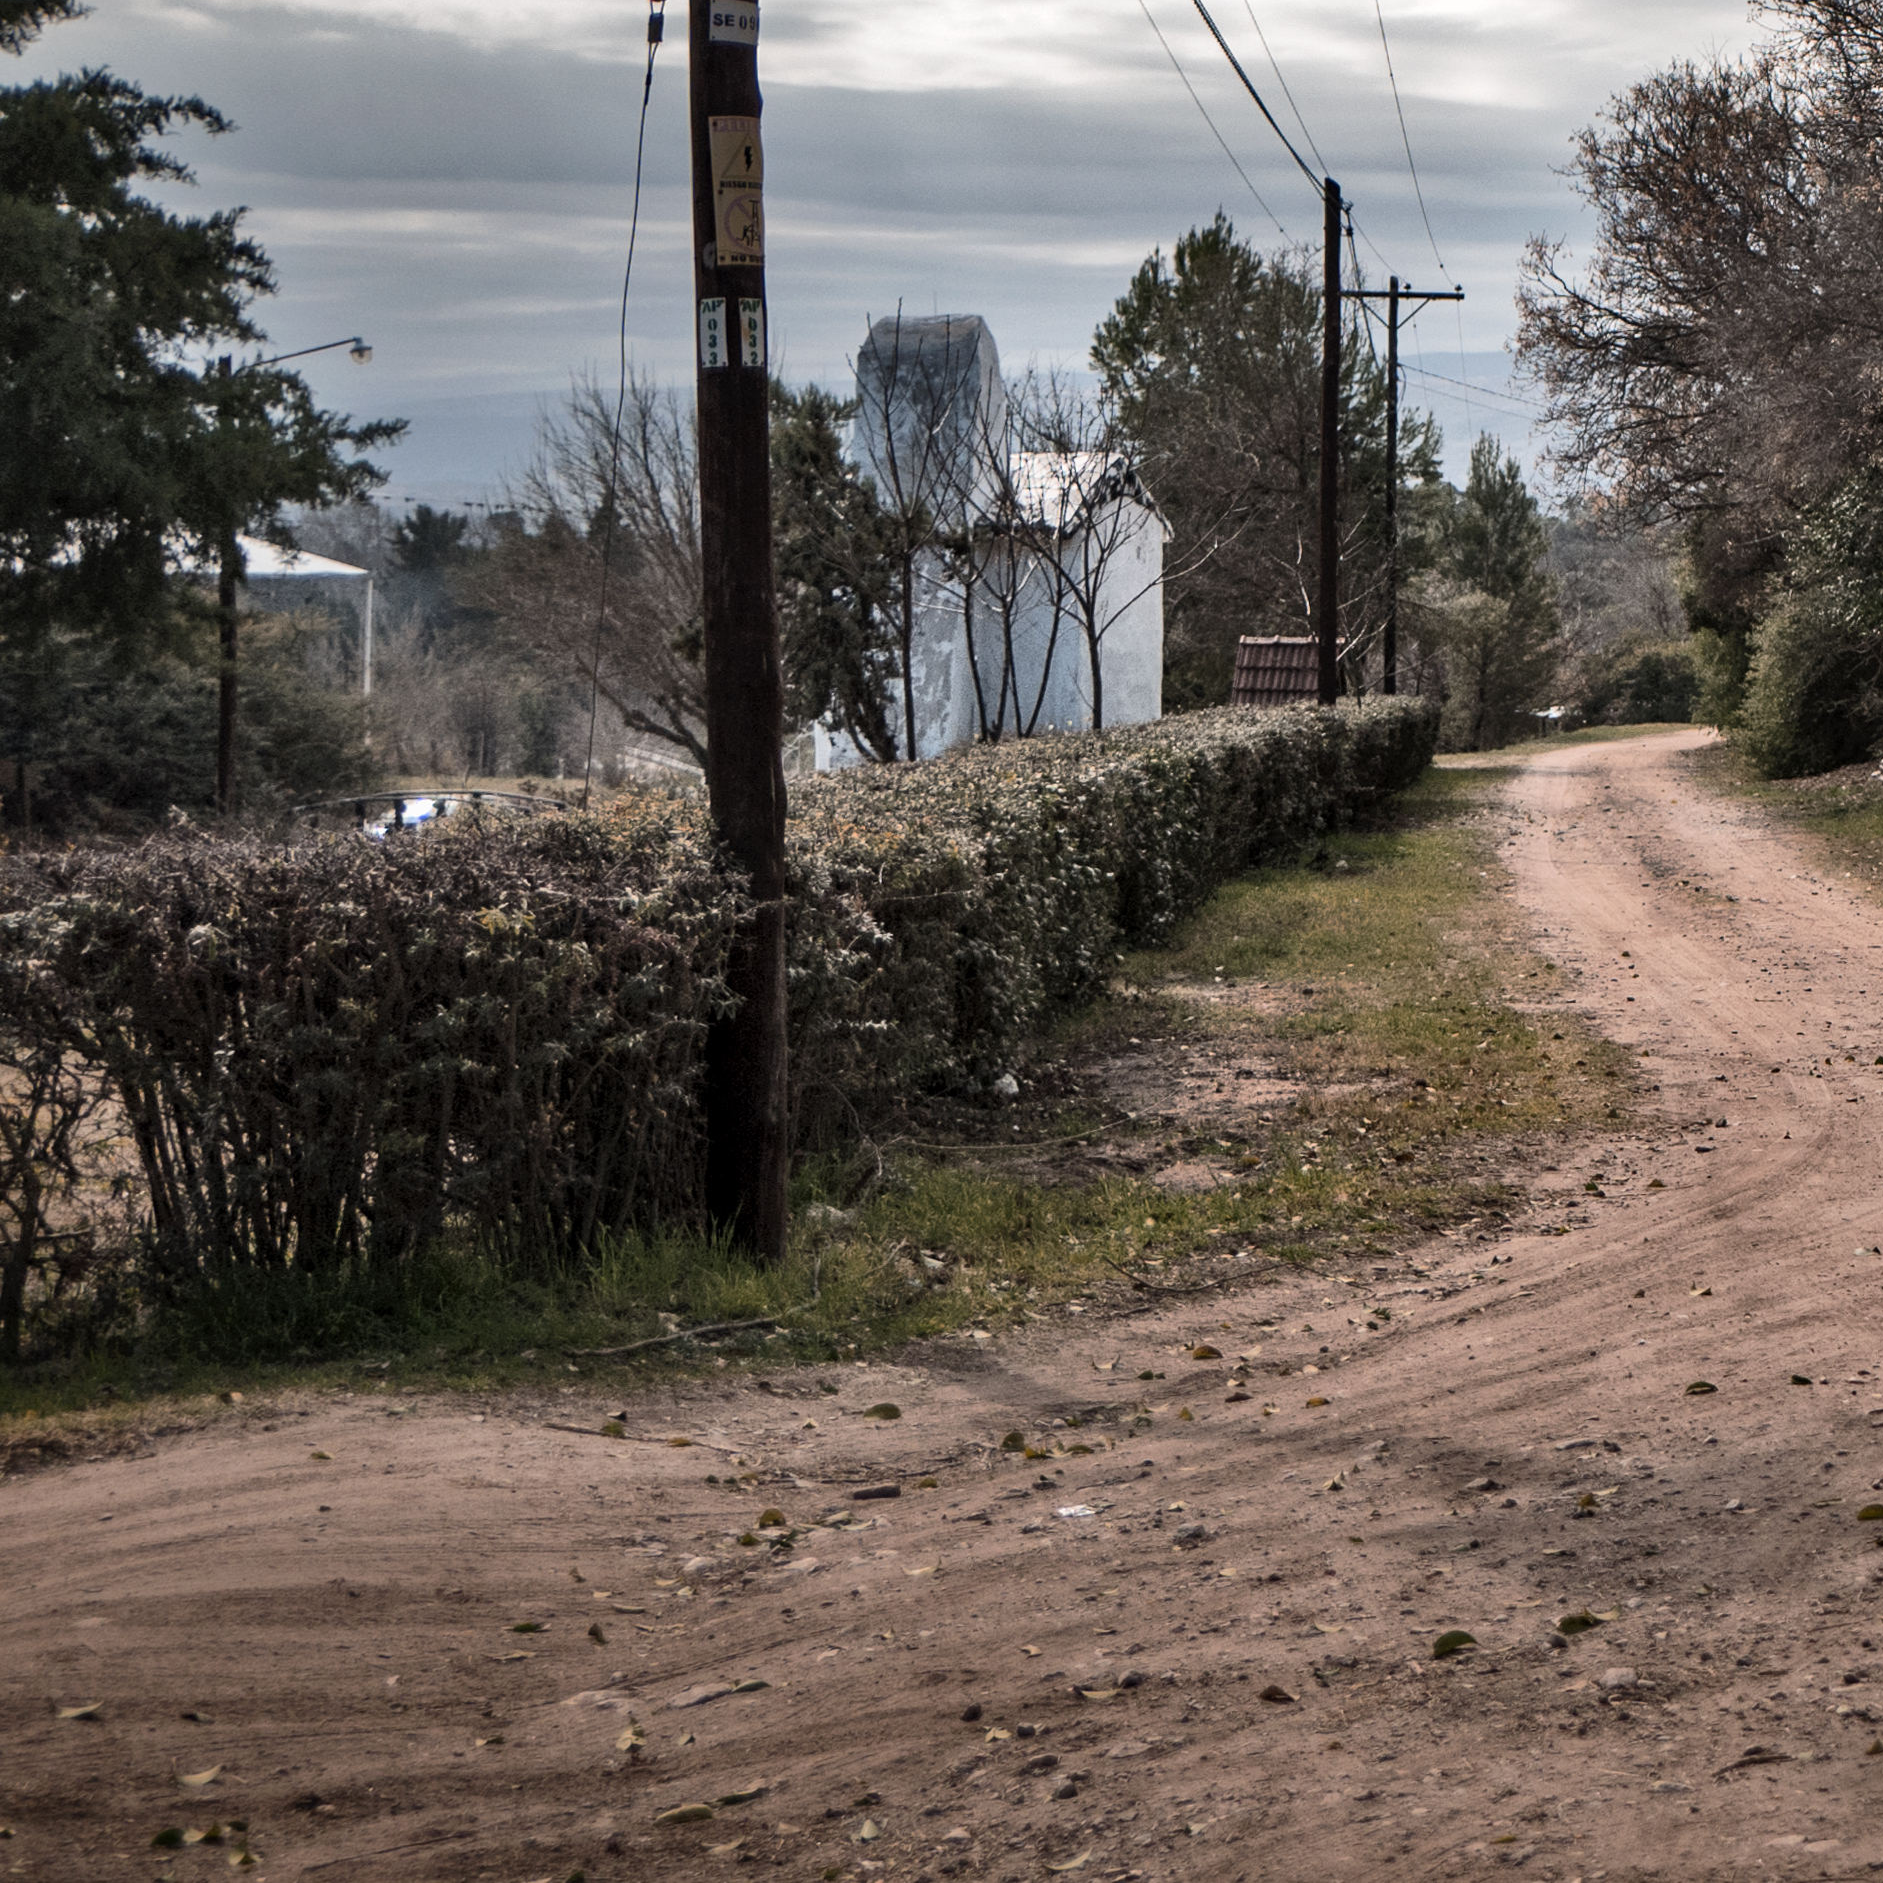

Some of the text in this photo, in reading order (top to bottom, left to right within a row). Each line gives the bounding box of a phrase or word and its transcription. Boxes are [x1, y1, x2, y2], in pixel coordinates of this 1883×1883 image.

[713, 13, 758, 31] SE 09
[731, 254, 747, 263] NO
[702, 300, 722, 313] AP
[742, 300, 761, 313] AP
